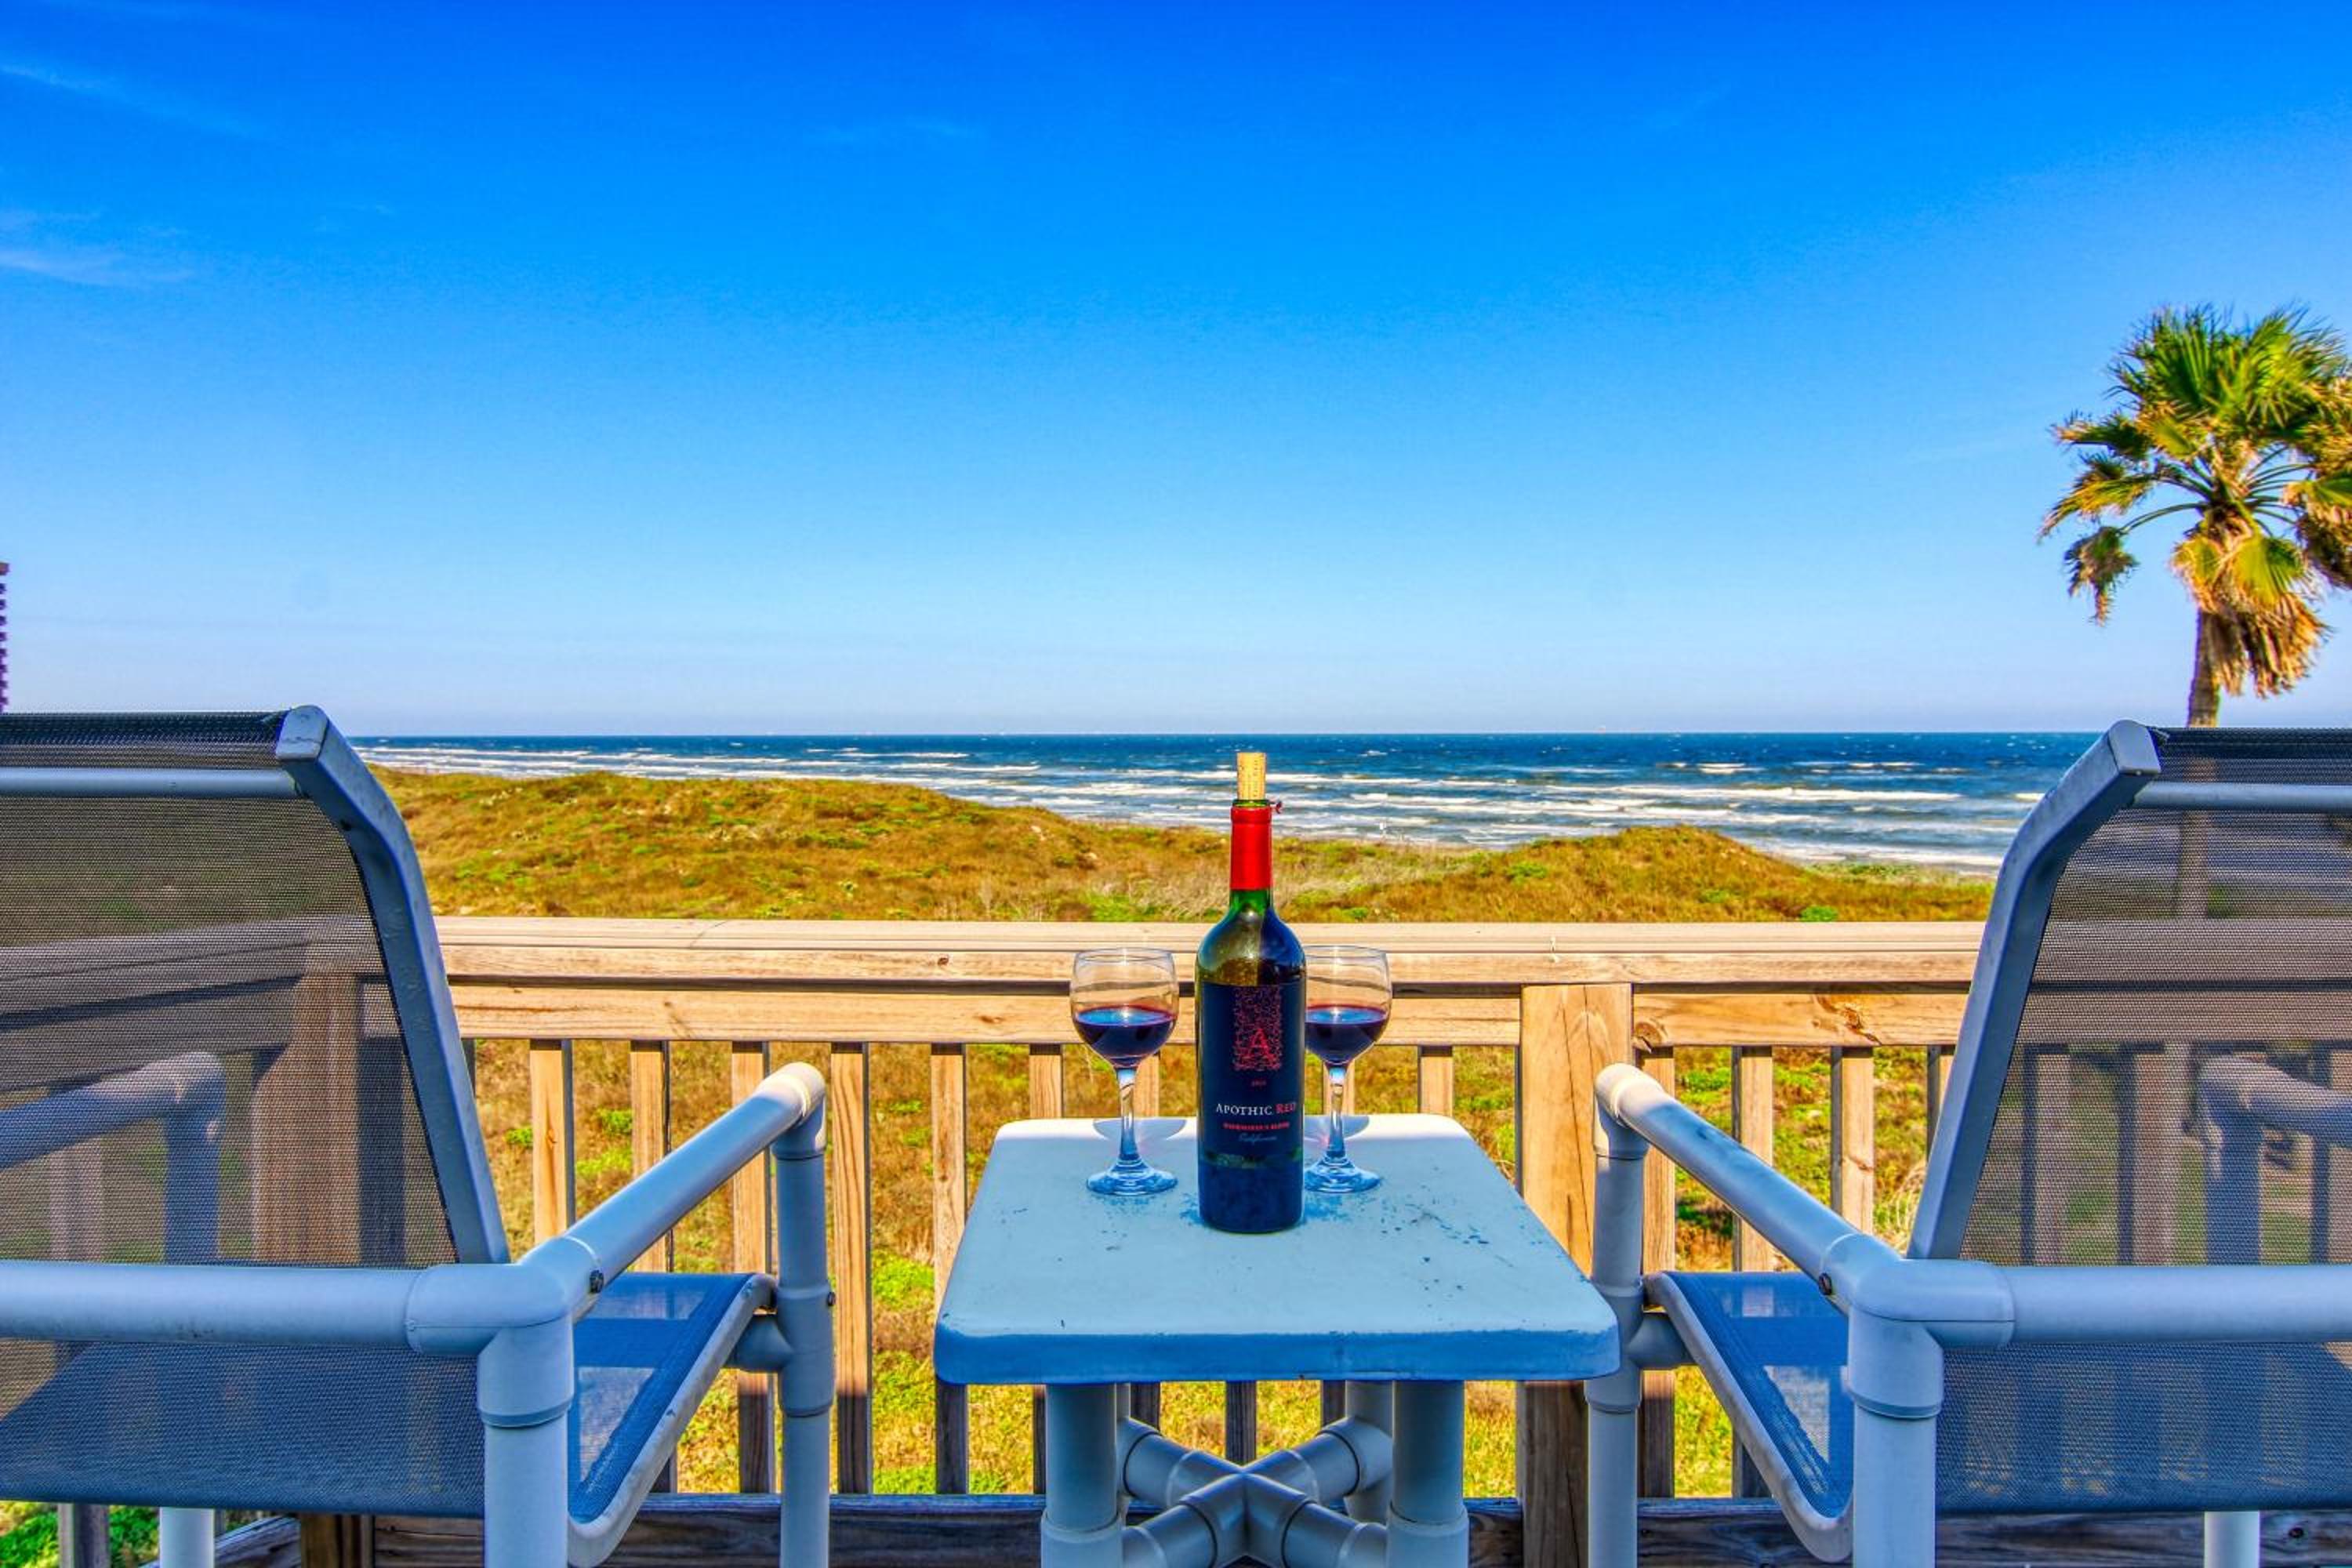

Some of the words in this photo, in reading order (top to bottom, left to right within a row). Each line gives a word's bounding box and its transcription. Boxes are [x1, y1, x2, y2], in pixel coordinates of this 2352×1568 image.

[1241, 1028, 1276, 1062] A
[1216, 1103, 1273, 1115] APOTHIC
[1275, 1102, 1296, 1113] RED
